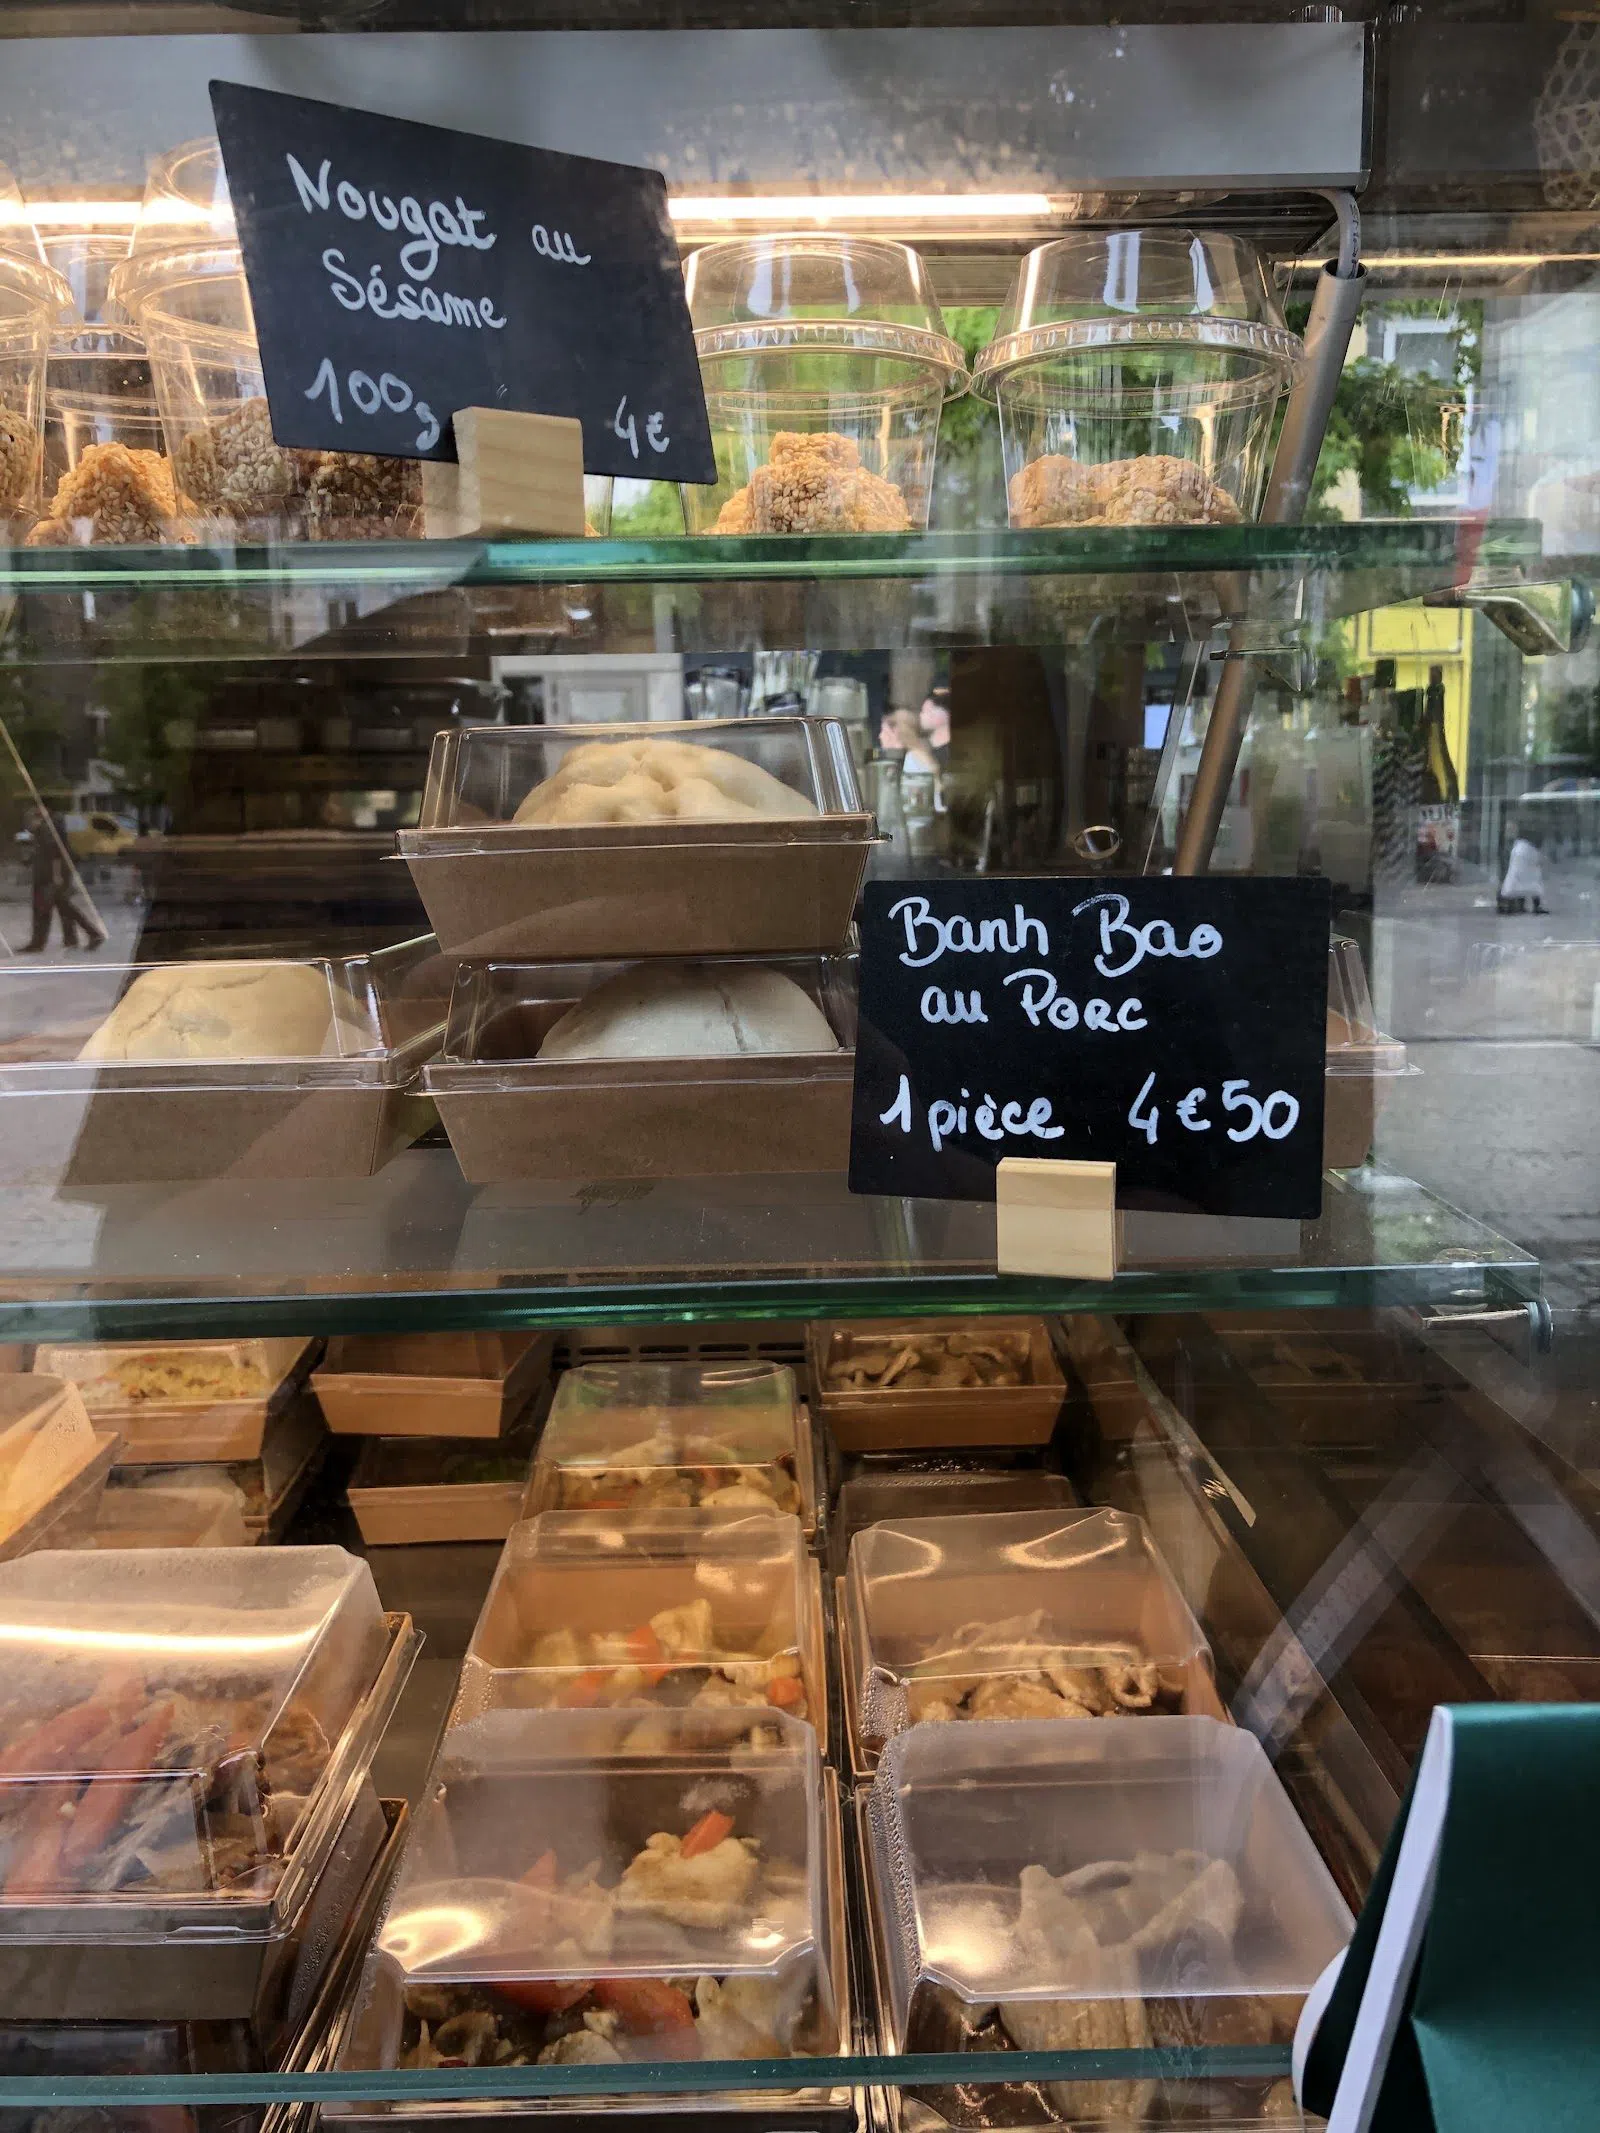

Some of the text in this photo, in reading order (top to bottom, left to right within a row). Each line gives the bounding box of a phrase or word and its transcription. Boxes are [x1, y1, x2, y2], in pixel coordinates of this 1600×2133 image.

[286, 152, 592, 282] Nougat au
[322, 248, 508, 330] Sésame
[304, 357, 671, 459] 100g 4€
[888, 893, 1223, 978] Banh Bao
[920, 985, 989, 1024] au
[879, 1073, 912, 1133] 1
[927, 1087, 1066, 1152] pièce
